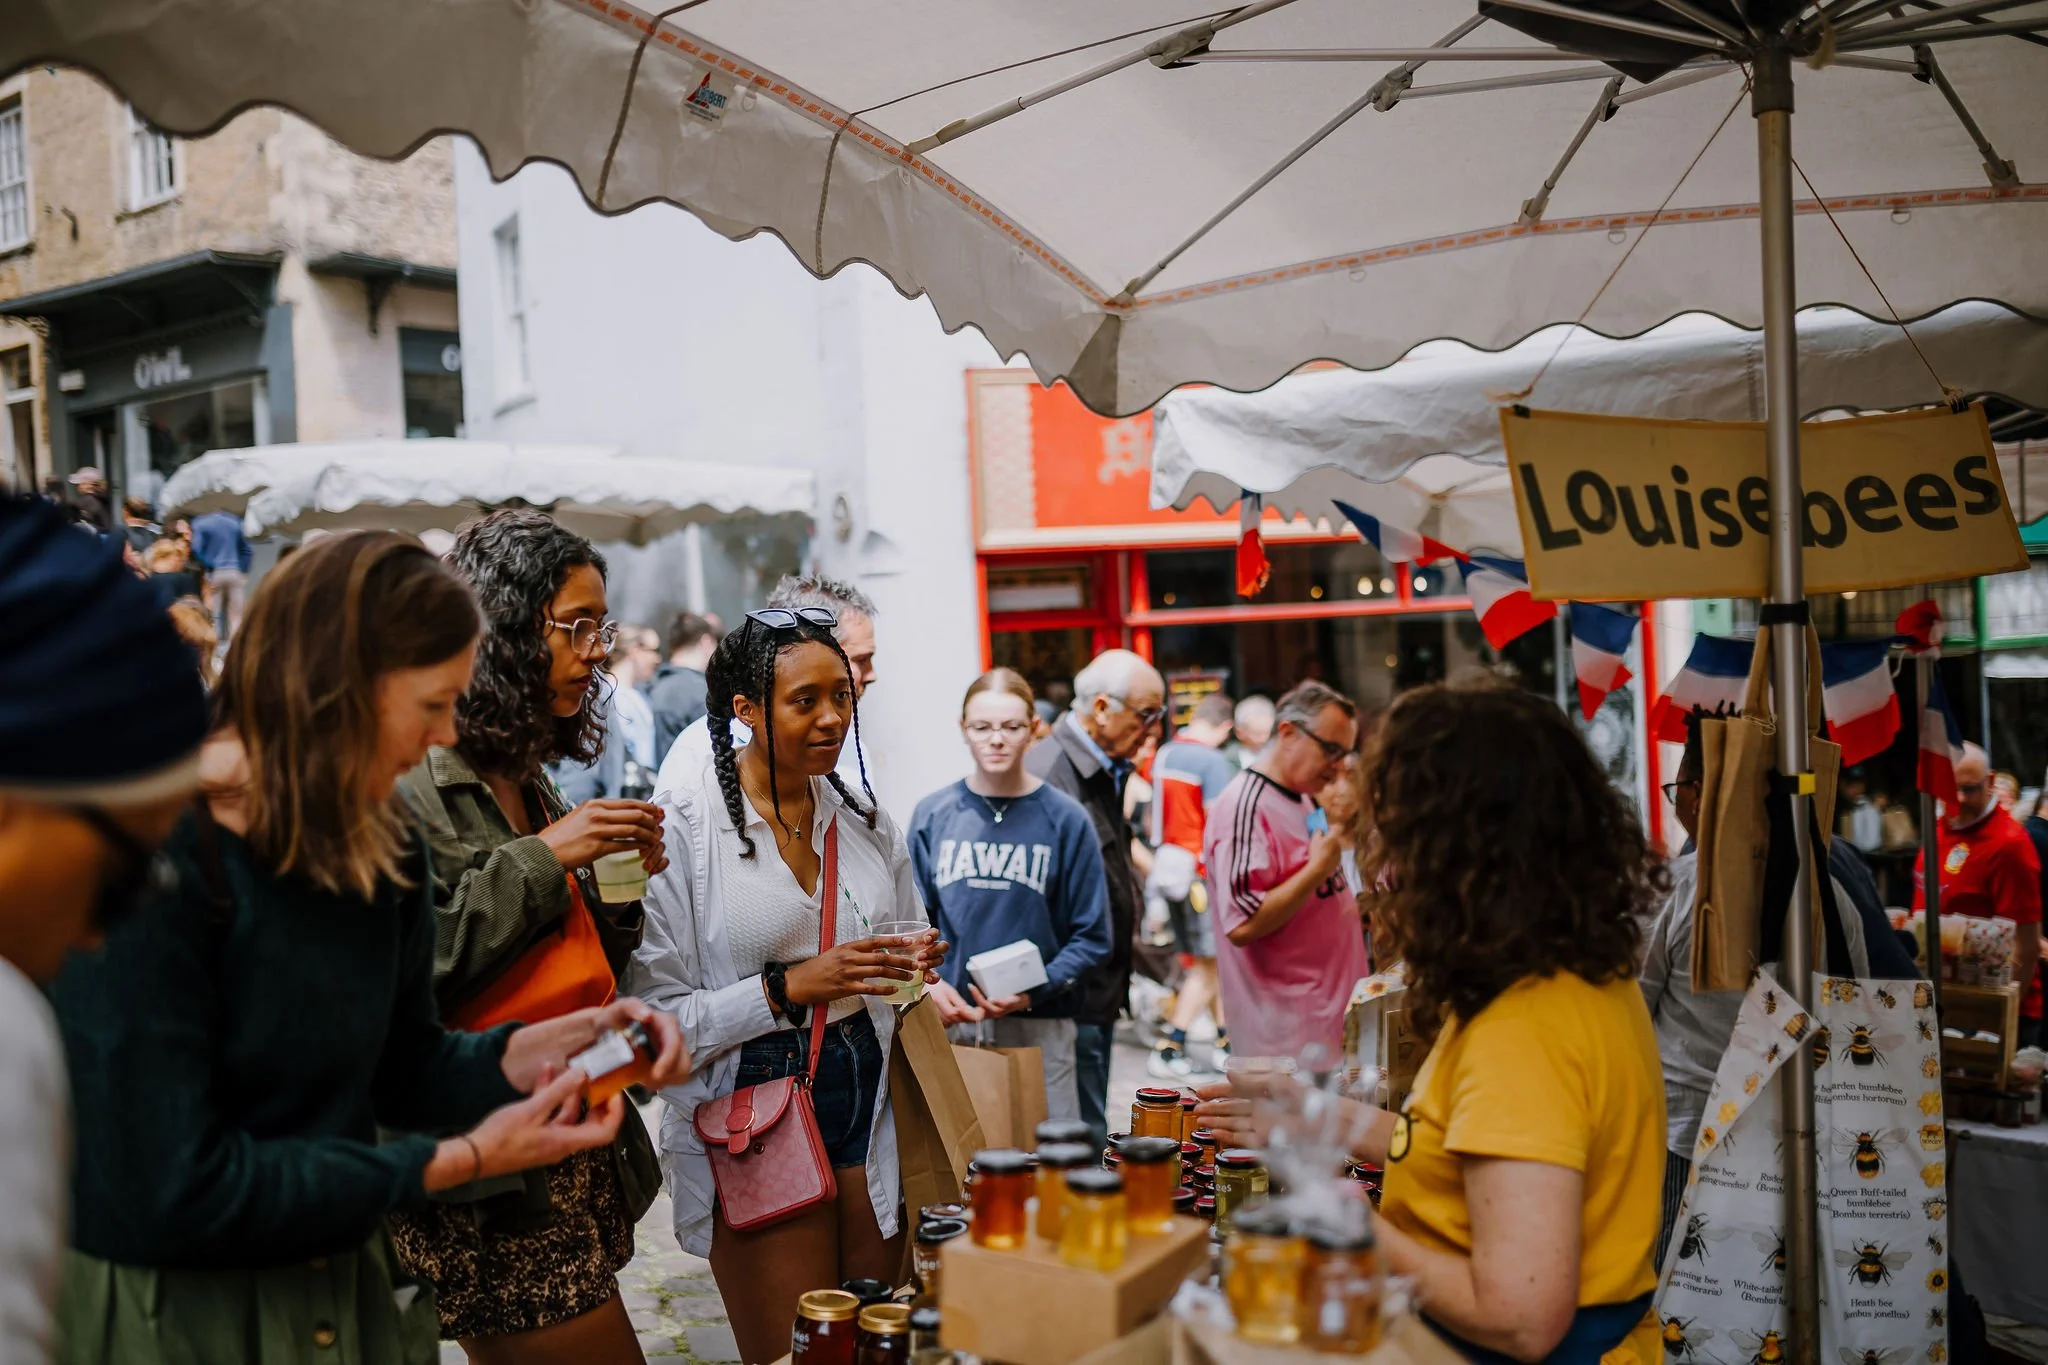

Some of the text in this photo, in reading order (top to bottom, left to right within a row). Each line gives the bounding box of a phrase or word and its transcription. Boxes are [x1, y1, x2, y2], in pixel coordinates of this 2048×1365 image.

[133, 346, 191, 389] OWL
[1831, 1082, 1903, 1095] arden bumblebee
[1832, 1092, 1860, 1101] ombus
[1722, 1168, 1736, 1178] bee
[1756, 1182, 1785, 1195] (Bomb
[1830, 1187, 1906, 1198] Queen Buff-tailed
[1847, 1199, 1891, 1208] bumblebee
[1832, 1210, 1911, 1220] Bombus terrestris)
[1705, 1276, 1718, 1285] bee
[1683, 1281, 1722, 1296] cineraria)
[1734, 1280, 1783, 1294] White-tailed
[1850, 1299, 1893, 1307] Heath bee
